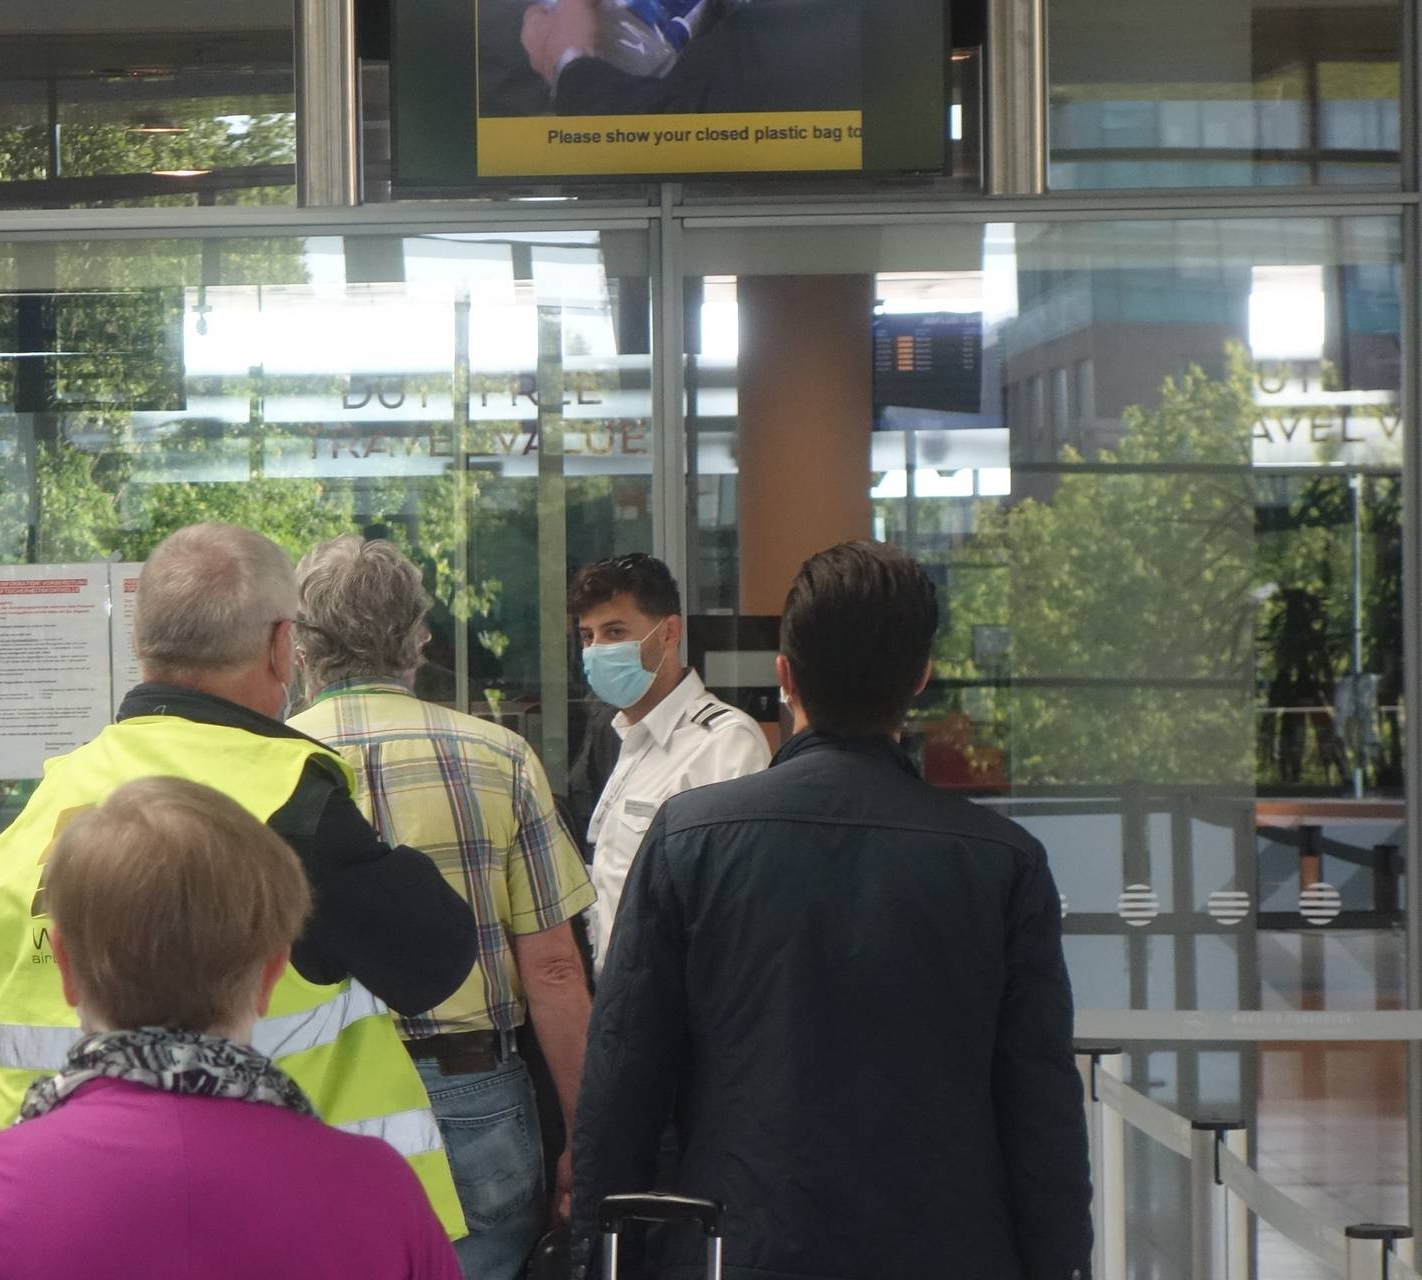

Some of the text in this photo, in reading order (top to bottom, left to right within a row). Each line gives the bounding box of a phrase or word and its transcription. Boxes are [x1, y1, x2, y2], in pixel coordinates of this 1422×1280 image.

[548, 124, 862, 146] Please show your closed plastic bag to
